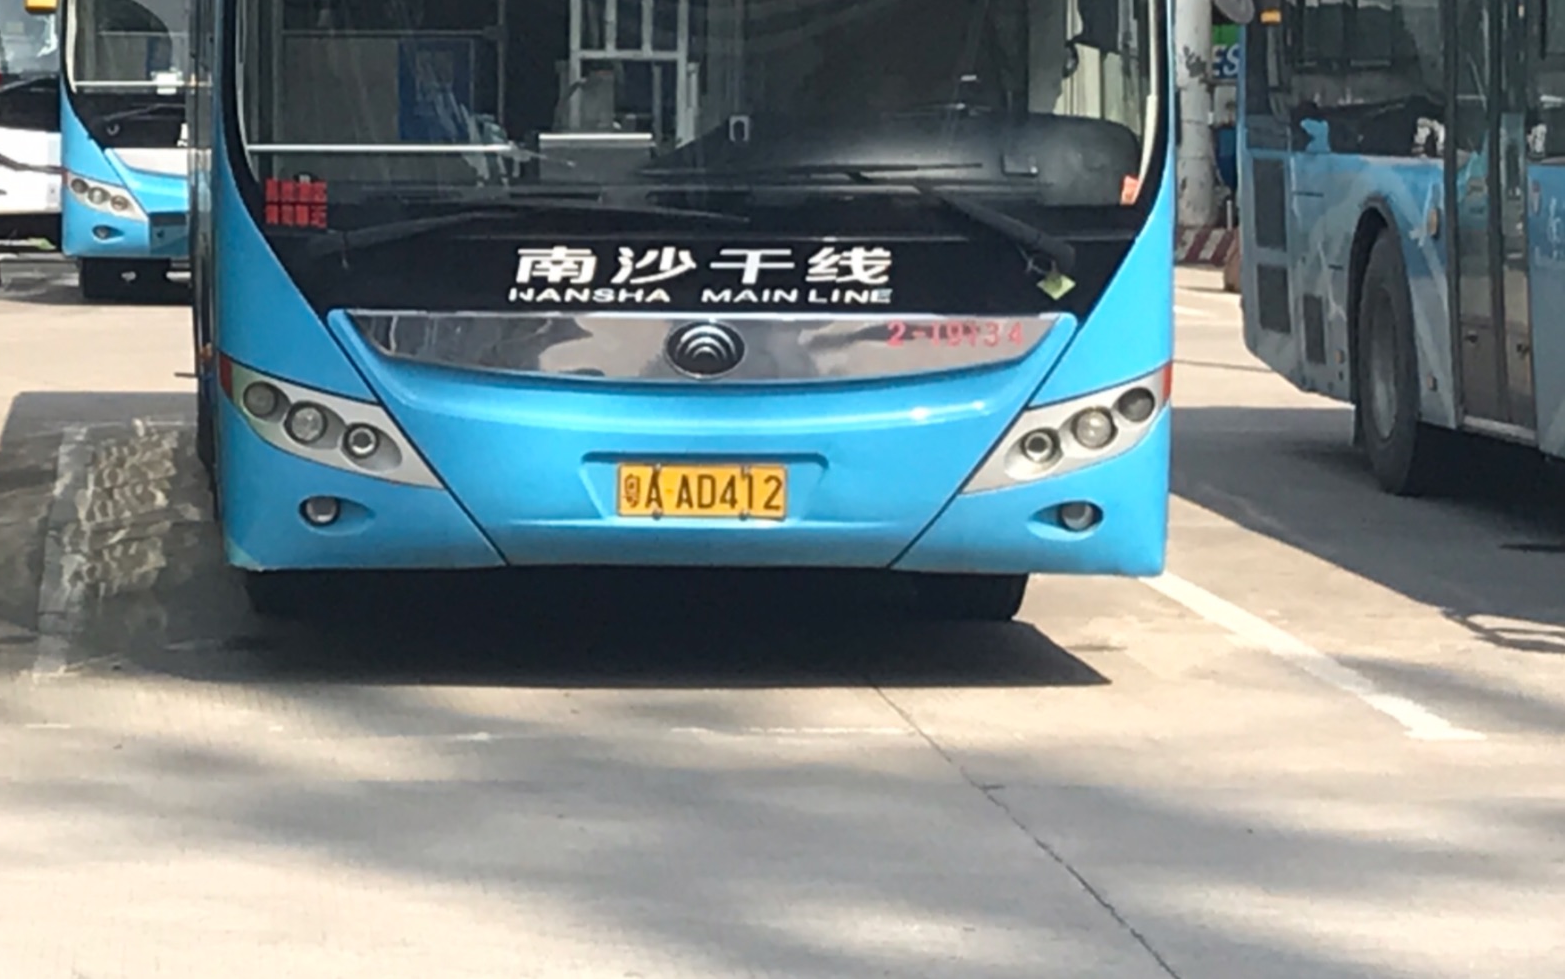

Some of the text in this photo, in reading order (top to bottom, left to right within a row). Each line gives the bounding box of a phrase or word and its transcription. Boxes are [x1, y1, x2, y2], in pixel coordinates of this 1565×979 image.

[515, 245, 893, 285] 南沙干线
[507, 287, 893, 303] NANSHA MAIN LINE
